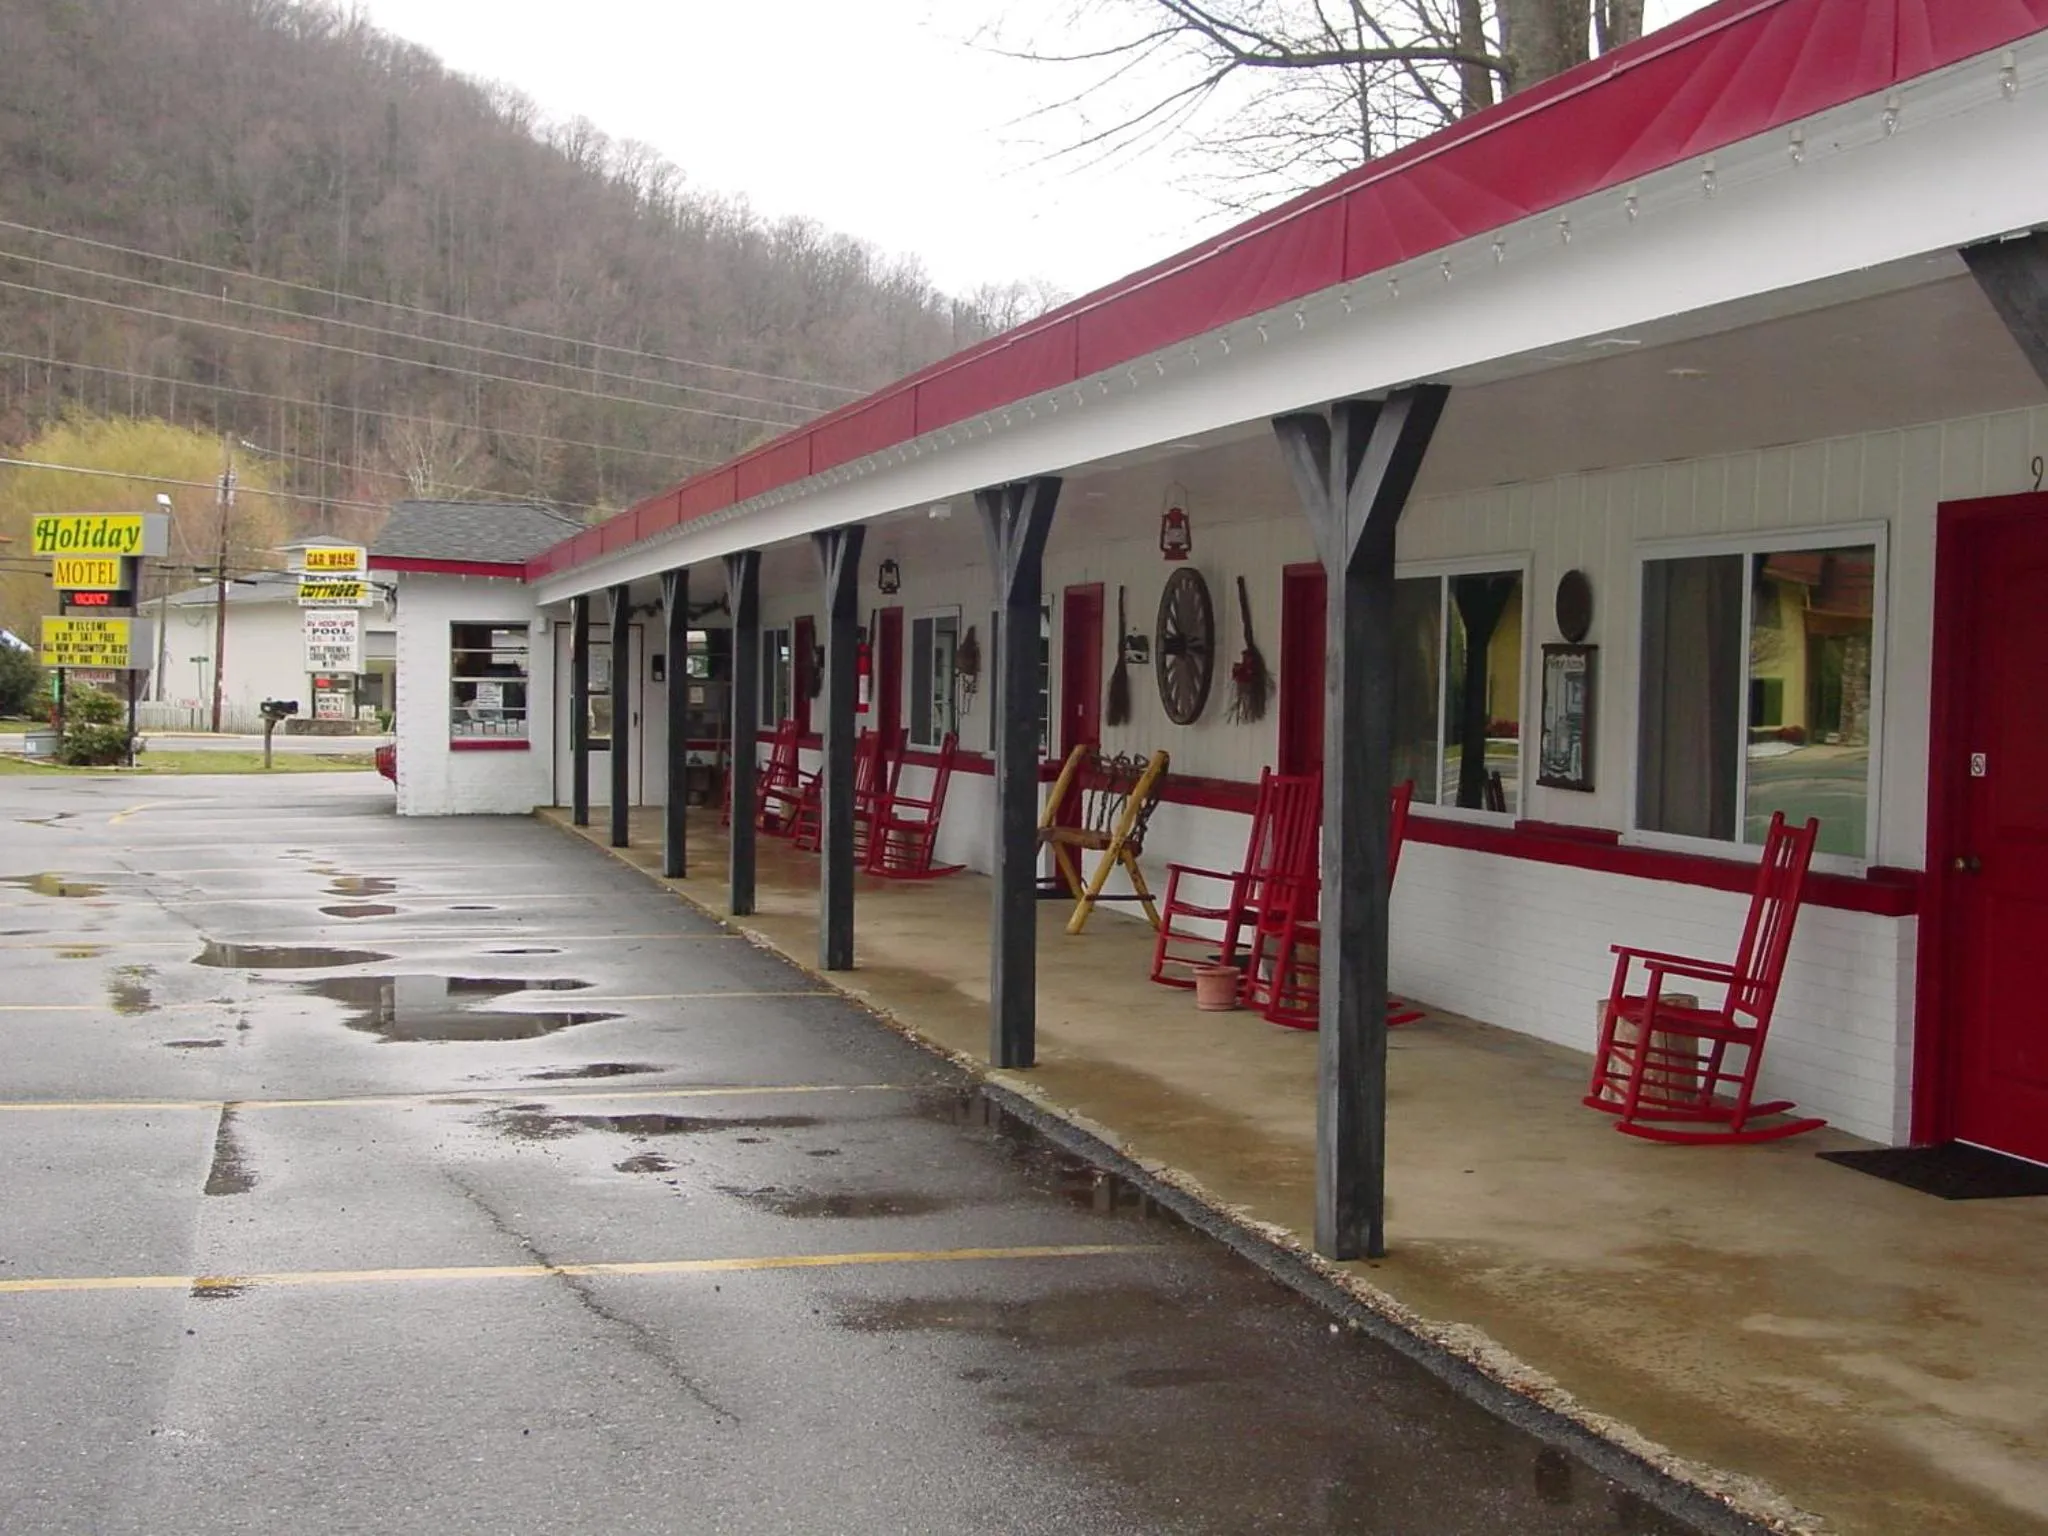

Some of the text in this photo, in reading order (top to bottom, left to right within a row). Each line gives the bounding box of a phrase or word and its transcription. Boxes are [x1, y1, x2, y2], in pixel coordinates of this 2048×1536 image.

[2031, 456, 2044, 491] 9
[36, 518, 140, 553] Holiday
[306, 553, 356, 566] CAR WASH
[55, 561, 118, 585] MOTEL
[300, 584, 361, 598] COTTAGES
[67, 621, 107, 632] WELCOME
